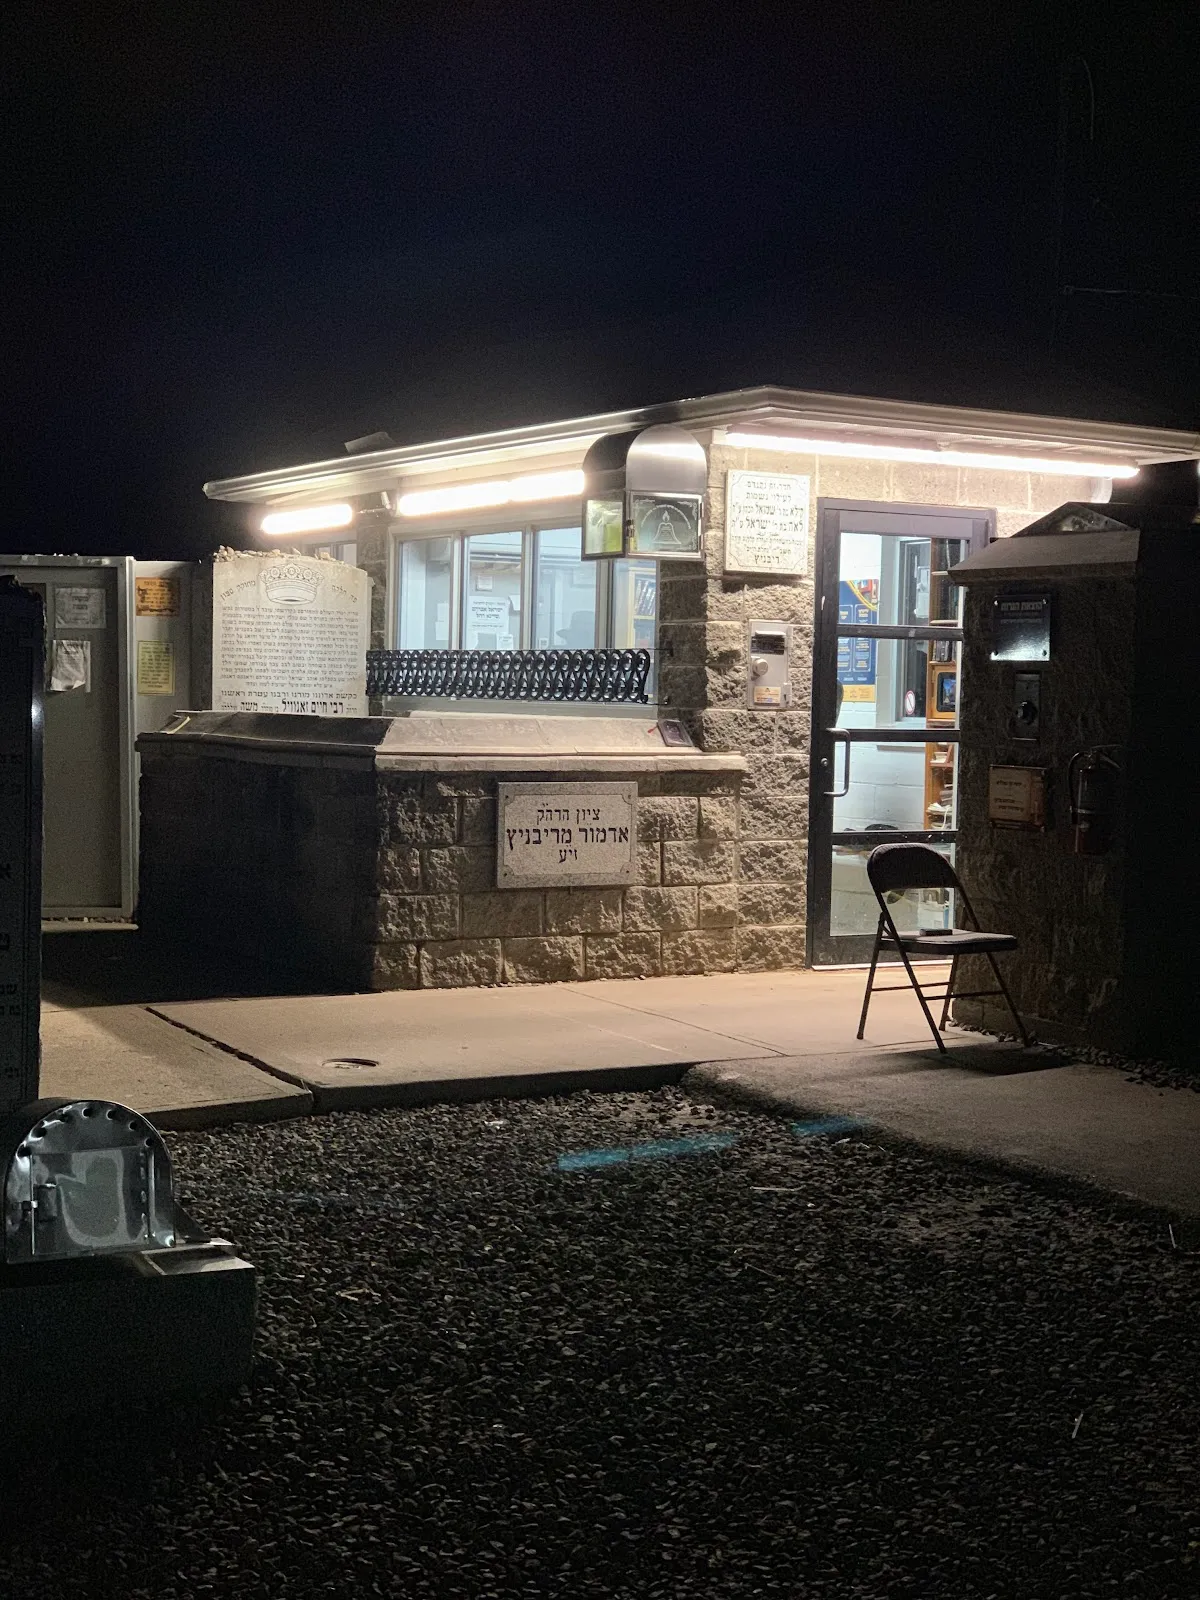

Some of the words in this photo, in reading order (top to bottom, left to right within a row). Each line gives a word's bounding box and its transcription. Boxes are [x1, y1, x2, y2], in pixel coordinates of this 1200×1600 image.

[754, 554, 780, 564] ריבניץ
[240, 701, 259, 711] משה
[311, 701, 328, 714] חיים
[330, 701, 344, 714] רבי
[576, 809, 601, 824] ציון
[506, 828, 572, 850] מריבניץ
